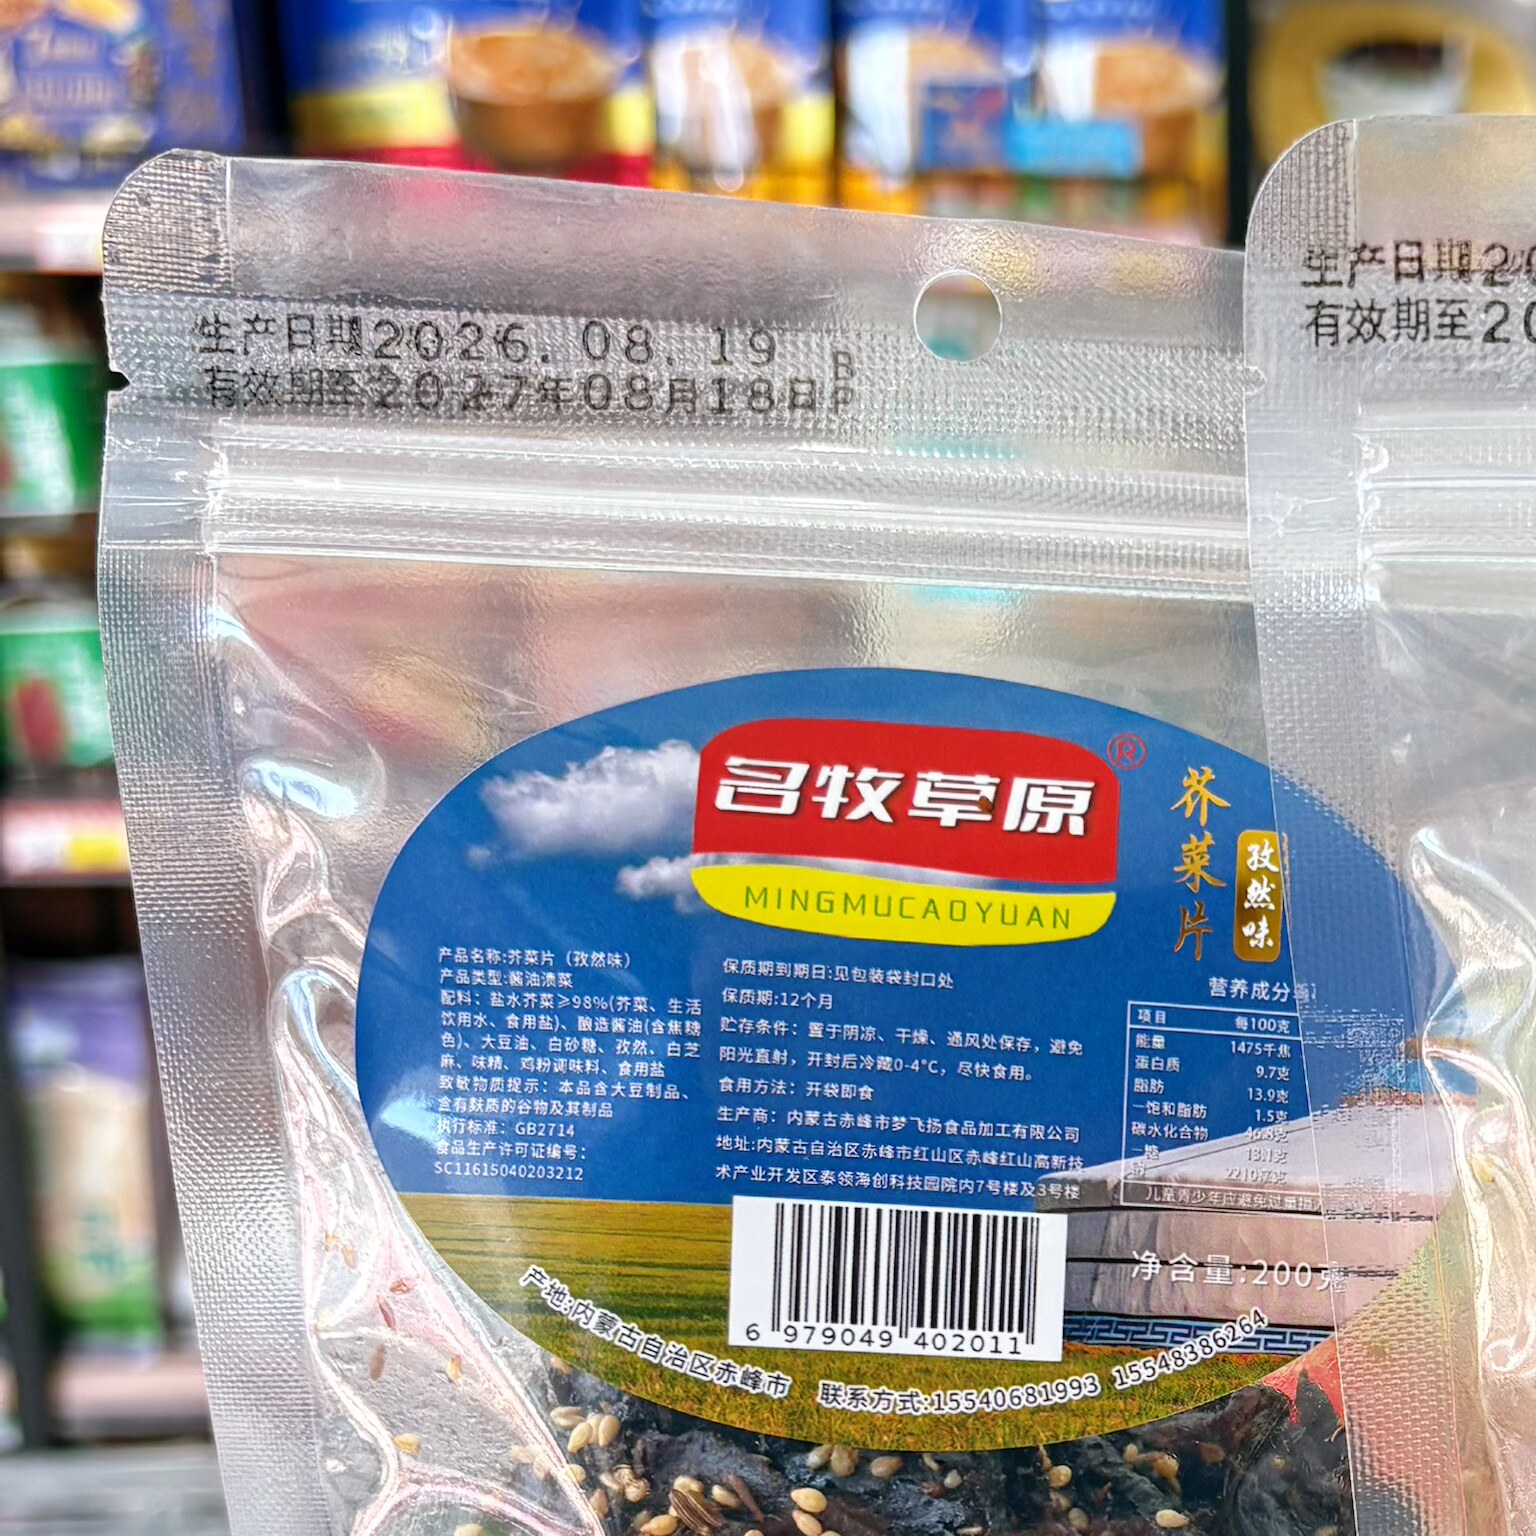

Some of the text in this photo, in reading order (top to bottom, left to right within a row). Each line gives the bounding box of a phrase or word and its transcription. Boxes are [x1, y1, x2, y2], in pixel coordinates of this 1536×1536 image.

[715, 756, 1096, 837] 名牧草原
[1171, 765, 1232, 962] 芥菜片
[744, 885, 1072, 931] MINGMUCAOYUAN
[1242, 839, 1279, 949] 孜然味
[722, 988, 833, 1010] 保质期:12个月
[1137, 1008, 1291, 1034] 项目 每100克
[1135, 1033, 1165, 1050] 能量
[1135, 1055, 1290, 1082] 蛋白质 9.7克
[1133, 1077, 1289, 1105] 脂肪 13.9克
[1131, 1121, 1209, 1141] 碳水化合物
[746, 1323, 1023, 1354] 6 979049 402011
[1113, 1307, 1268, 1389] 15548386264
